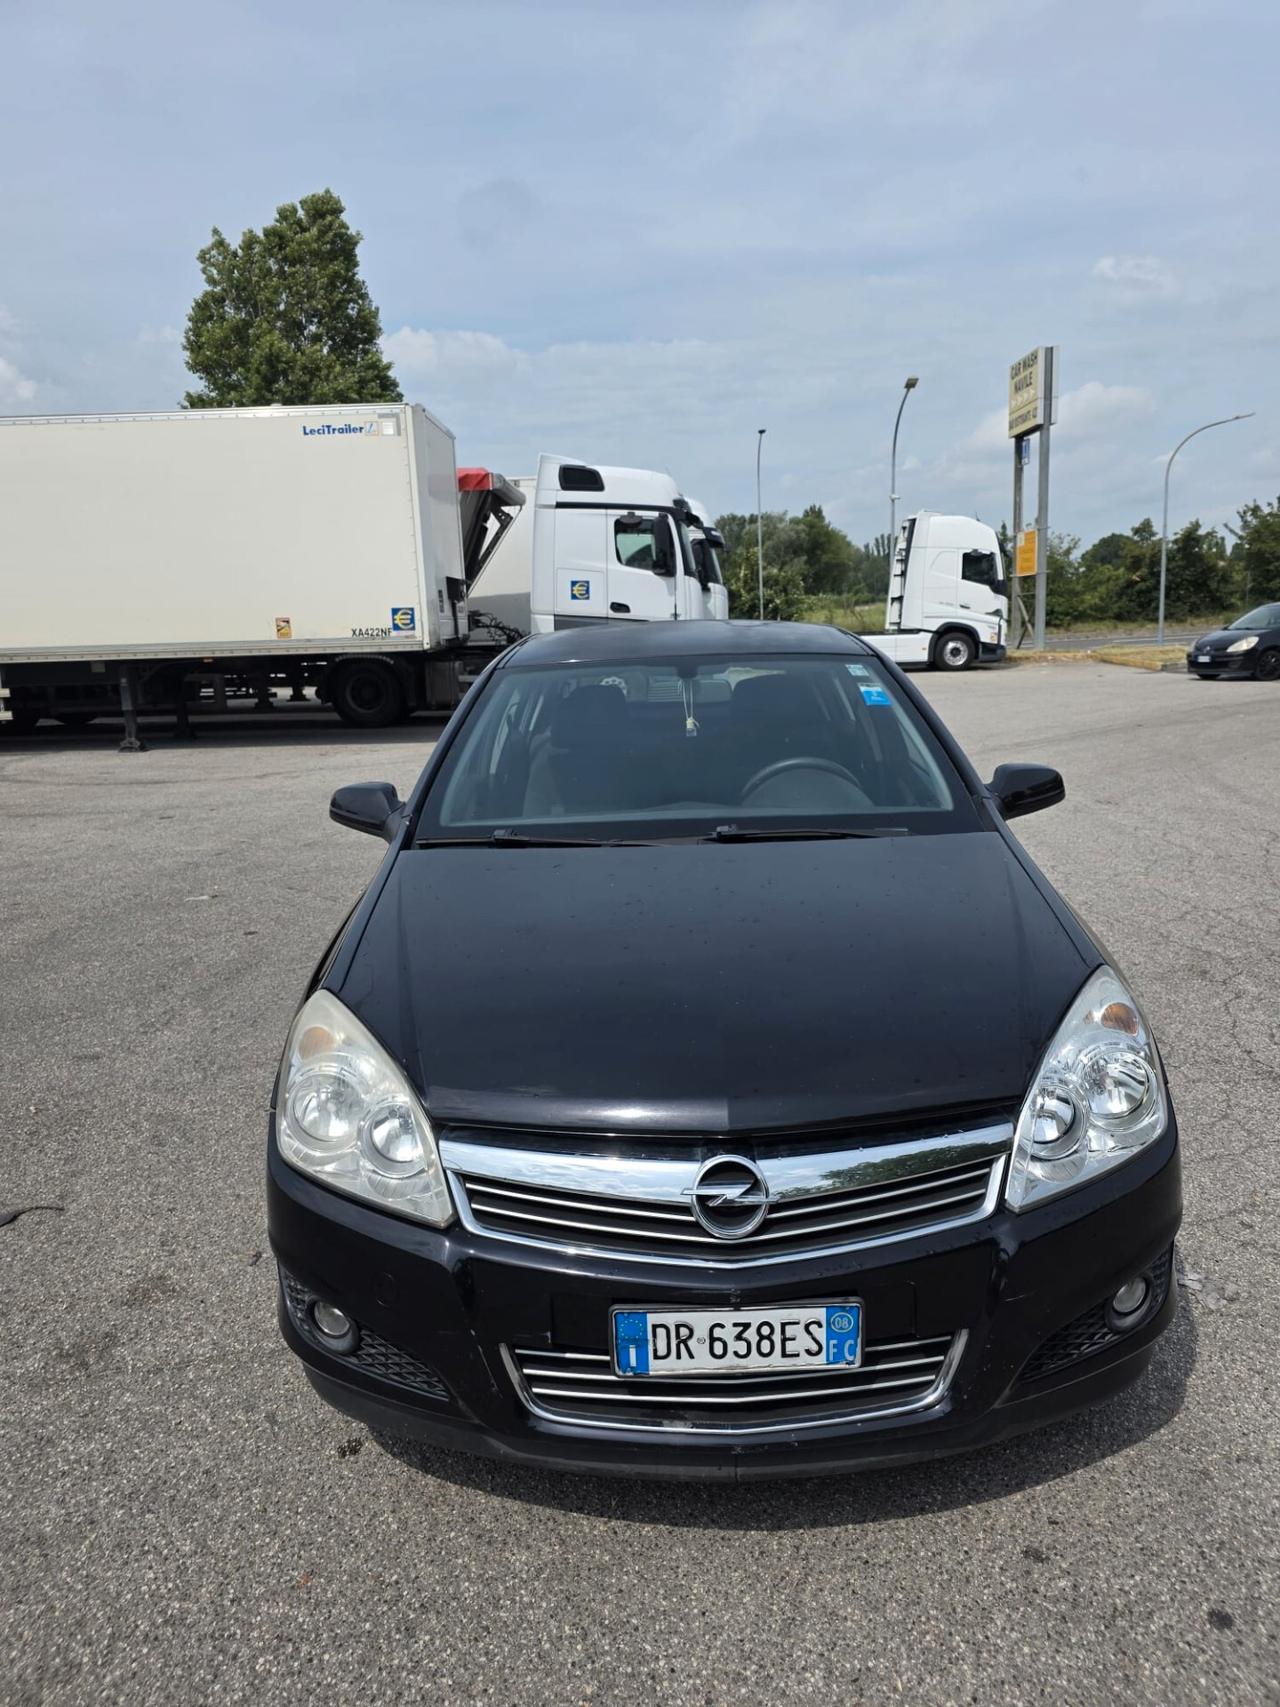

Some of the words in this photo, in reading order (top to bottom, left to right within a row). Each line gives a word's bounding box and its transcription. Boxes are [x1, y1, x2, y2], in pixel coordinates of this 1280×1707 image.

[1010, 361, 1022, 381] CAR
[1022, 349, 1038, 373] WASH
[1014, 370, 1033, 393] NAVILE
[302, 423, 364, 436] LeciTrailer
[351, 627, 392, 638] XA422NF
[833, 1317, 850, 1330] 08
